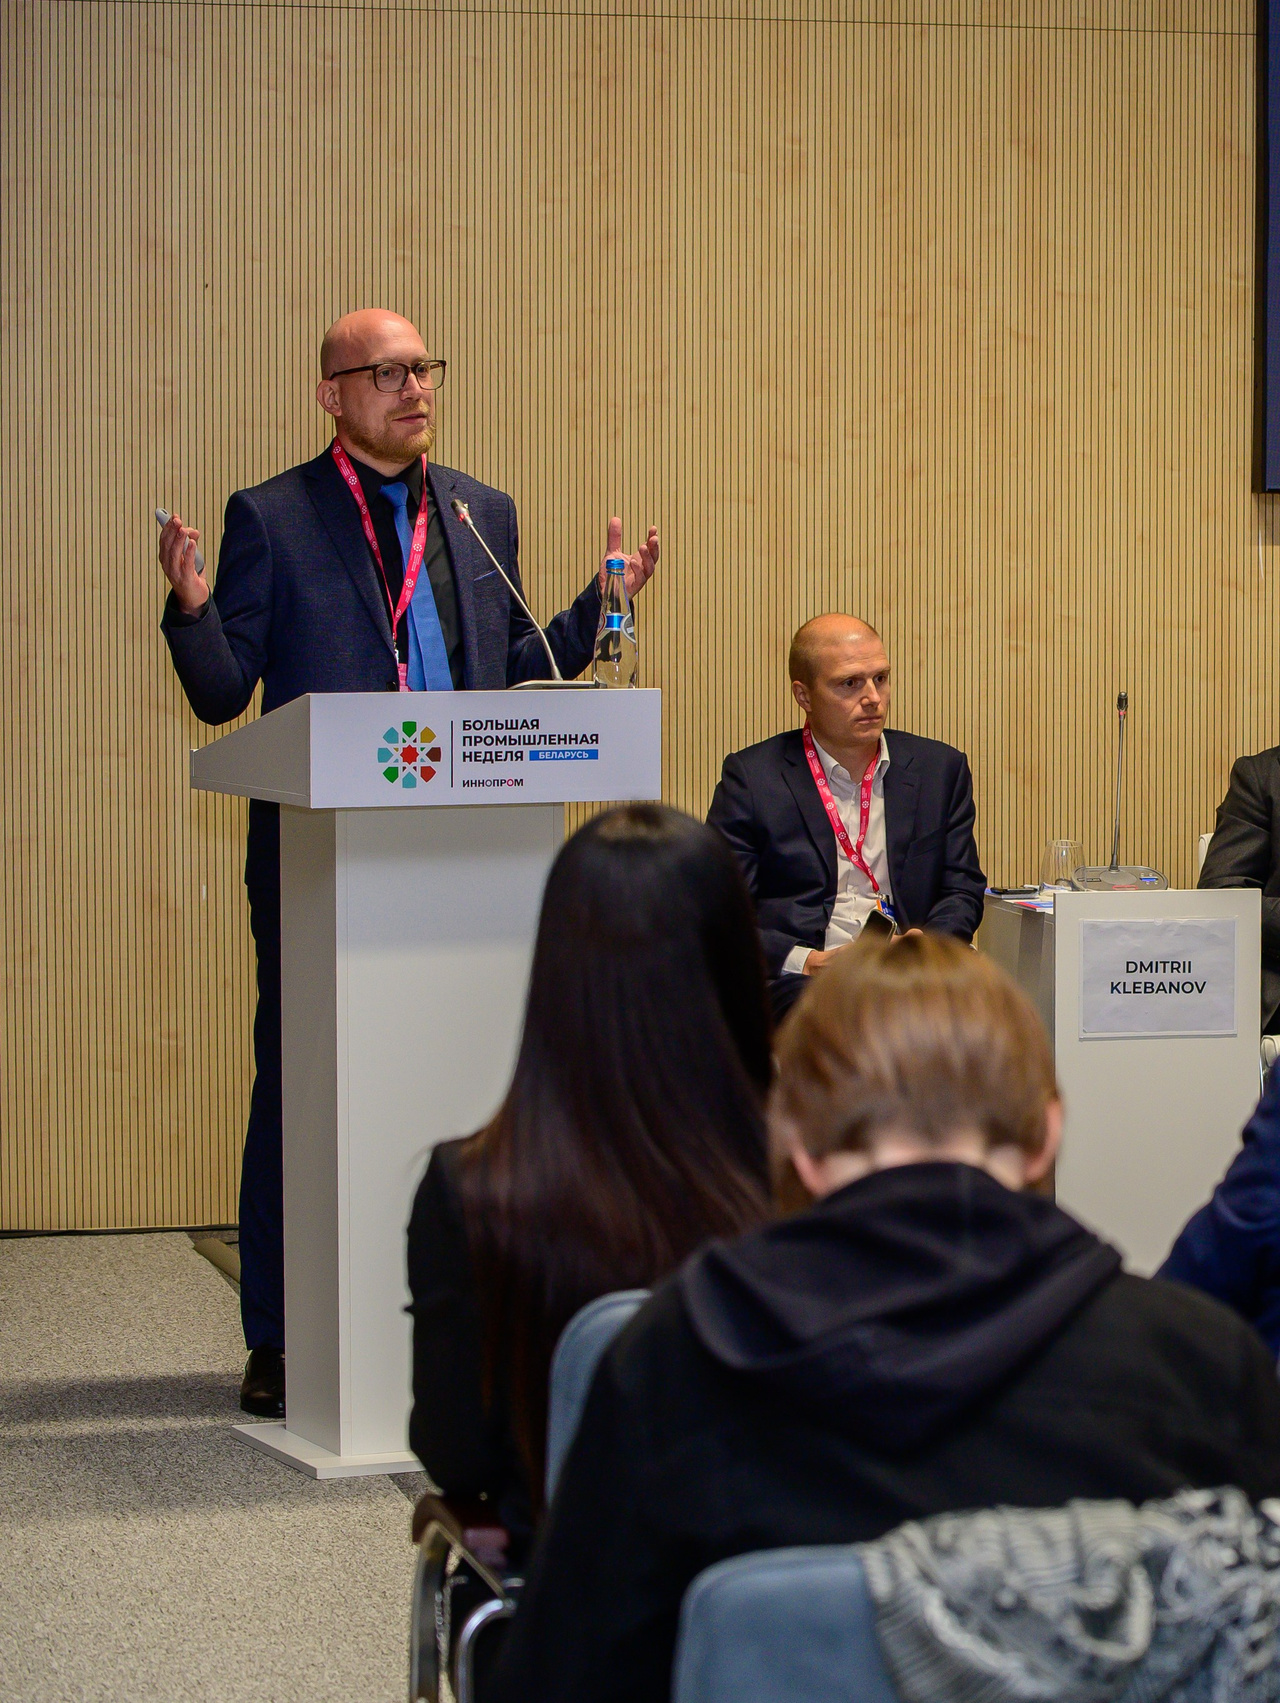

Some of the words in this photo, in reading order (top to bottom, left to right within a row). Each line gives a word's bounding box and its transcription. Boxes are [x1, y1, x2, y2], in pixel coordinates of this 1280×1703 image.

[462, 719, 540, 731] БОЛЬШАЯ
[462, 733, 599, 747] ПРОМЫШЛЕННАЯ
[462, 750, 524, 764] НЕДЕЛЯ
[538, 750, 589, 760] БЕЛАРУСЬ
[462, 778, 524, 788] ИННОПРОМ
[1125, 960, 1192, 974] DMITRII
[1110, 980, 1207, 995] KLEBANOV
